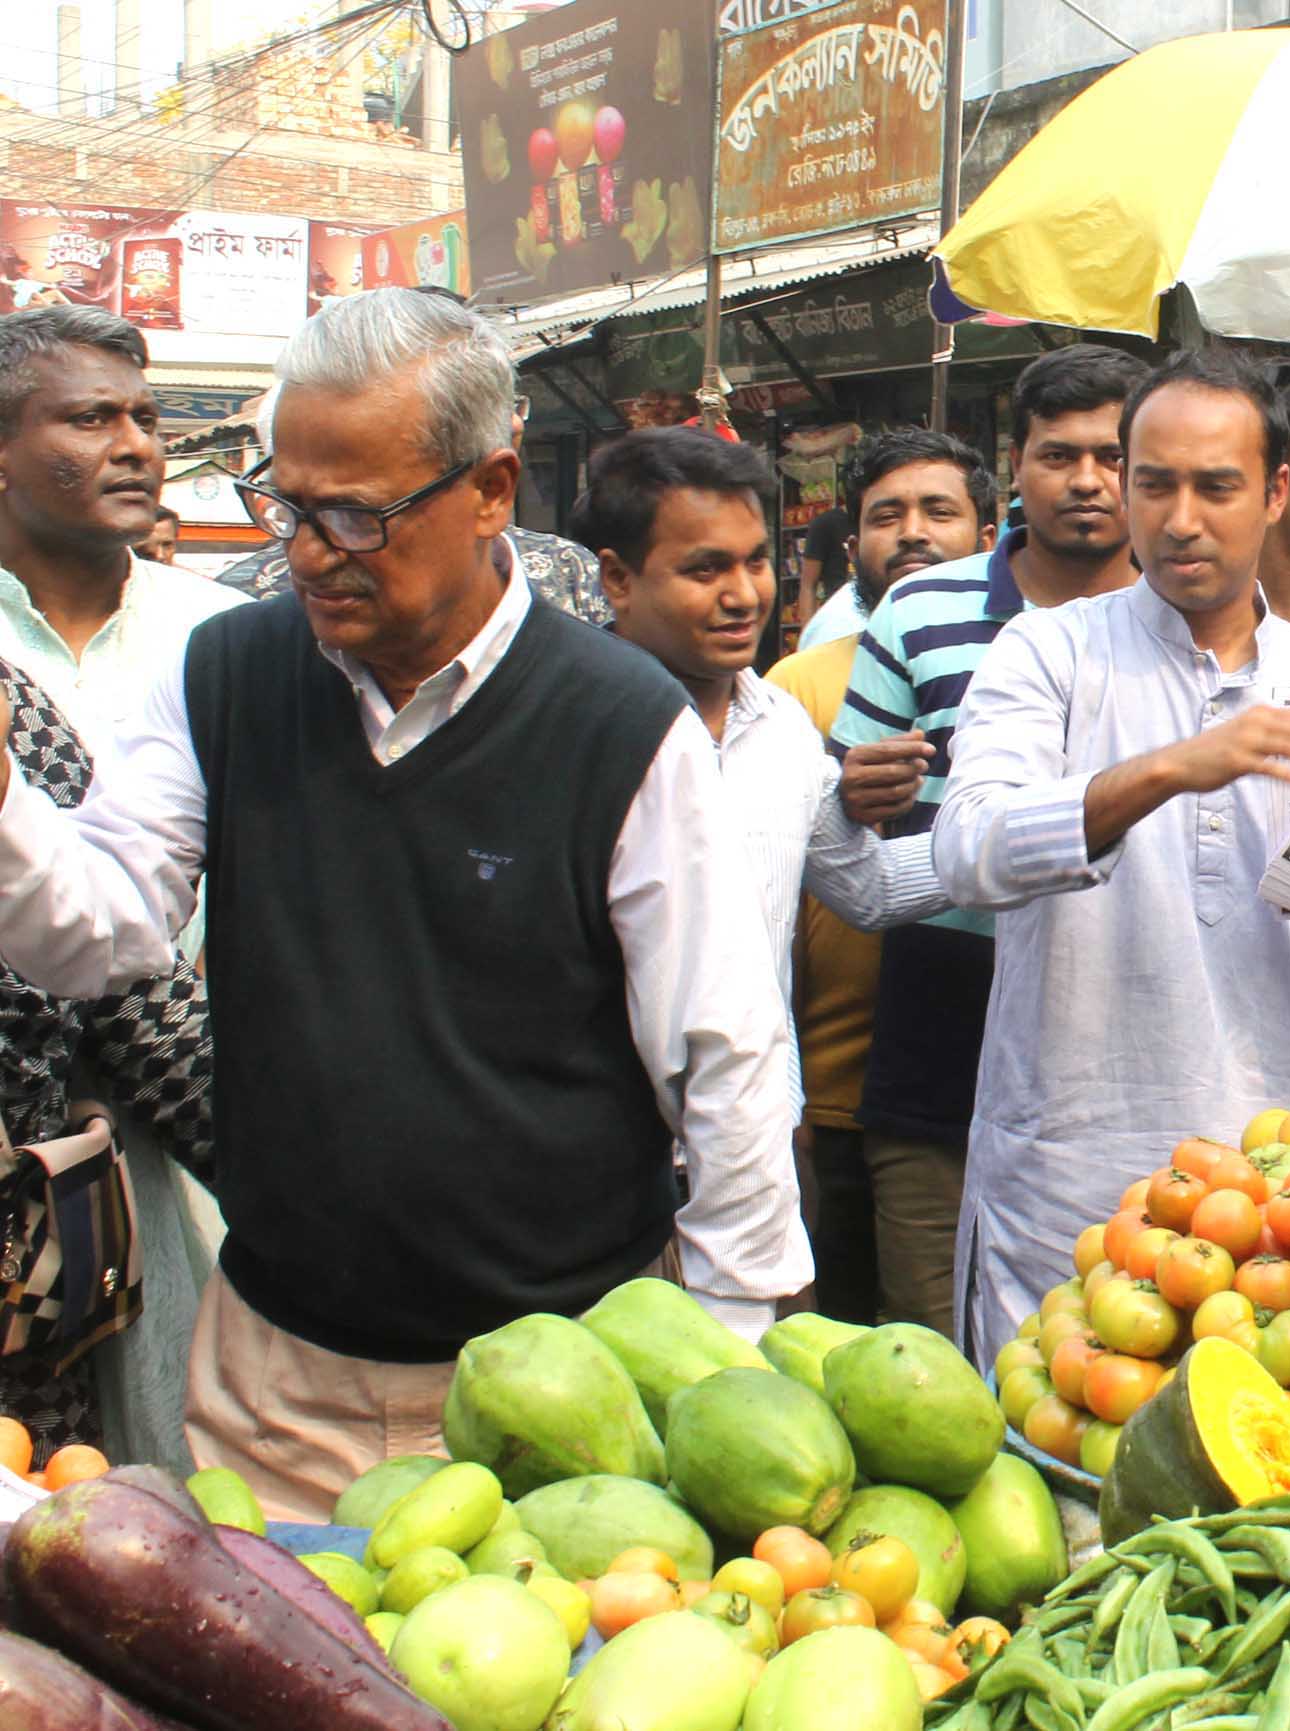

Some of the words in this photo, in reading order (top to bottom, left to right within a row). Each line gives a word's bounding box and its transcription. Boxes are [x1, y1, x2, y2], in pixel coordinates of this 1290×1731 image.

[187, 227, 245, 259] প্রাইম
[253, 229, 303, 264] ফার্মা
[466, 848, 513, 866] GANT
